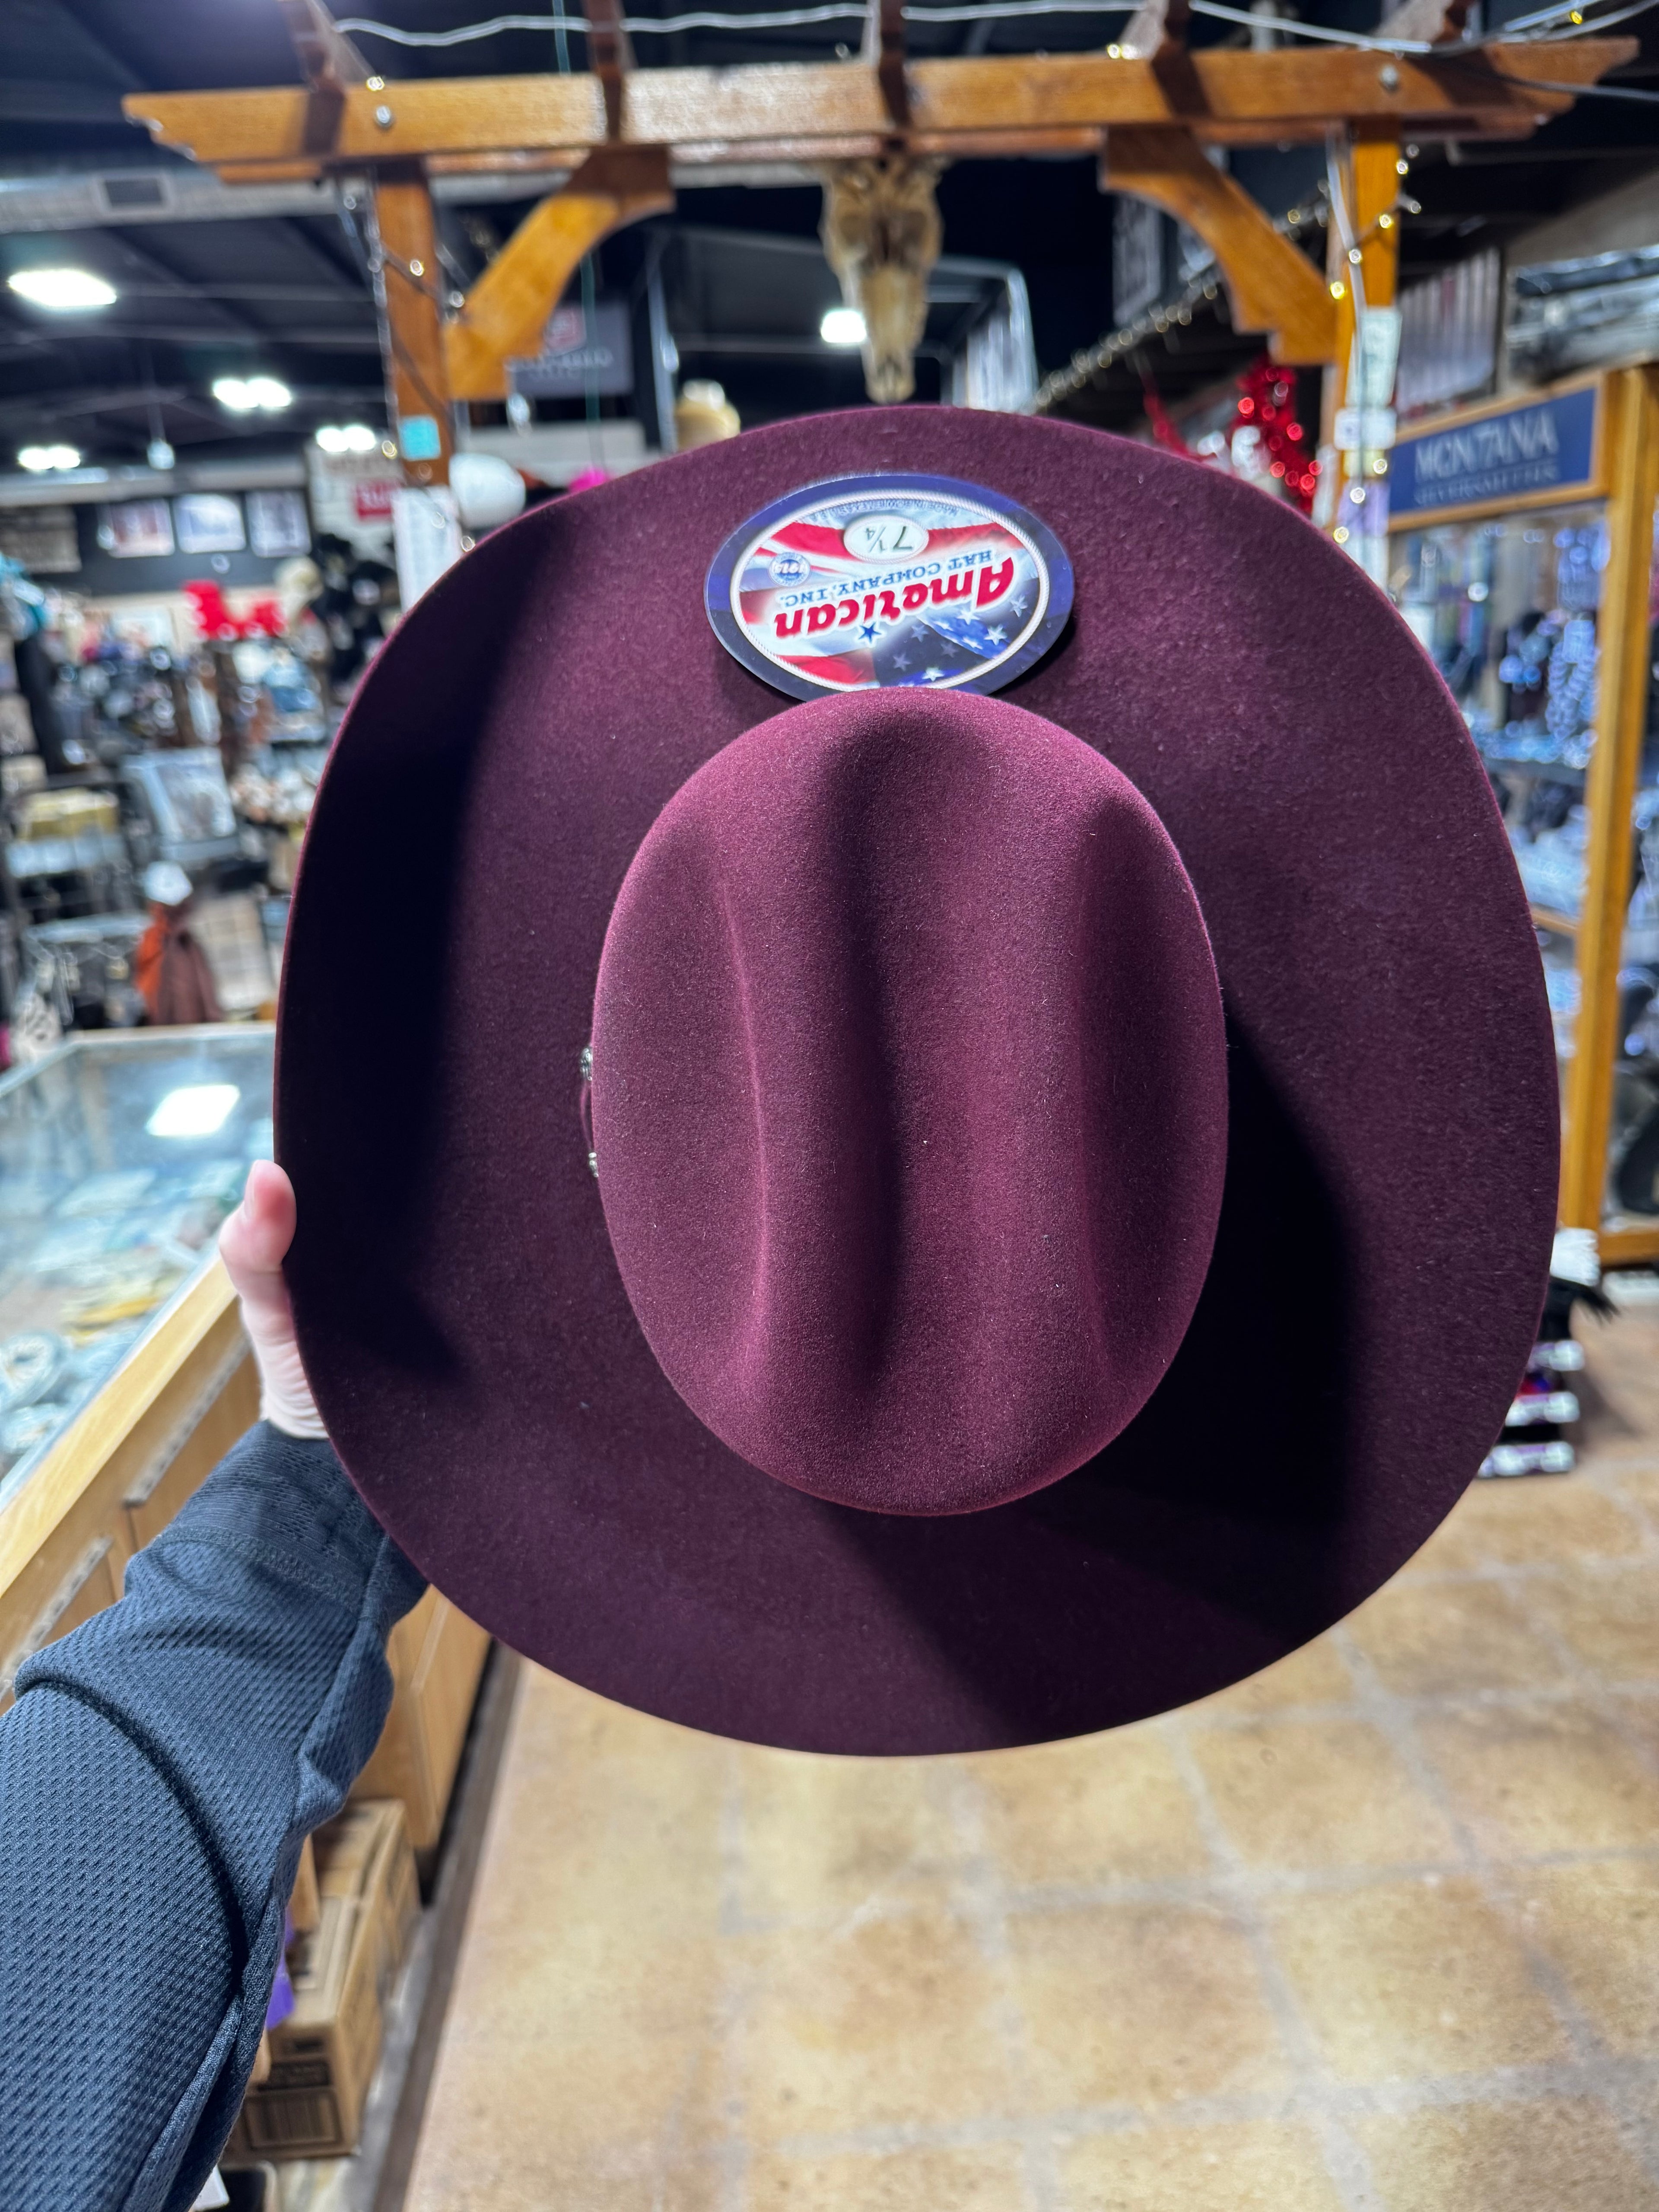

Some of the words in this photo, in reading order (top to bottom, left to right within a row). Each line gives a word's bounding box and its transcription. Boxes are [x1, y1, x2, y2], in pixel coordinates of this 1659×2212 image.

[1415, 408, 1559, 479] MONTANA
[947, 550, 992, 570] HAT
[773, 556, 1014, 638] American
[779, 588, 827, 607] INC.
